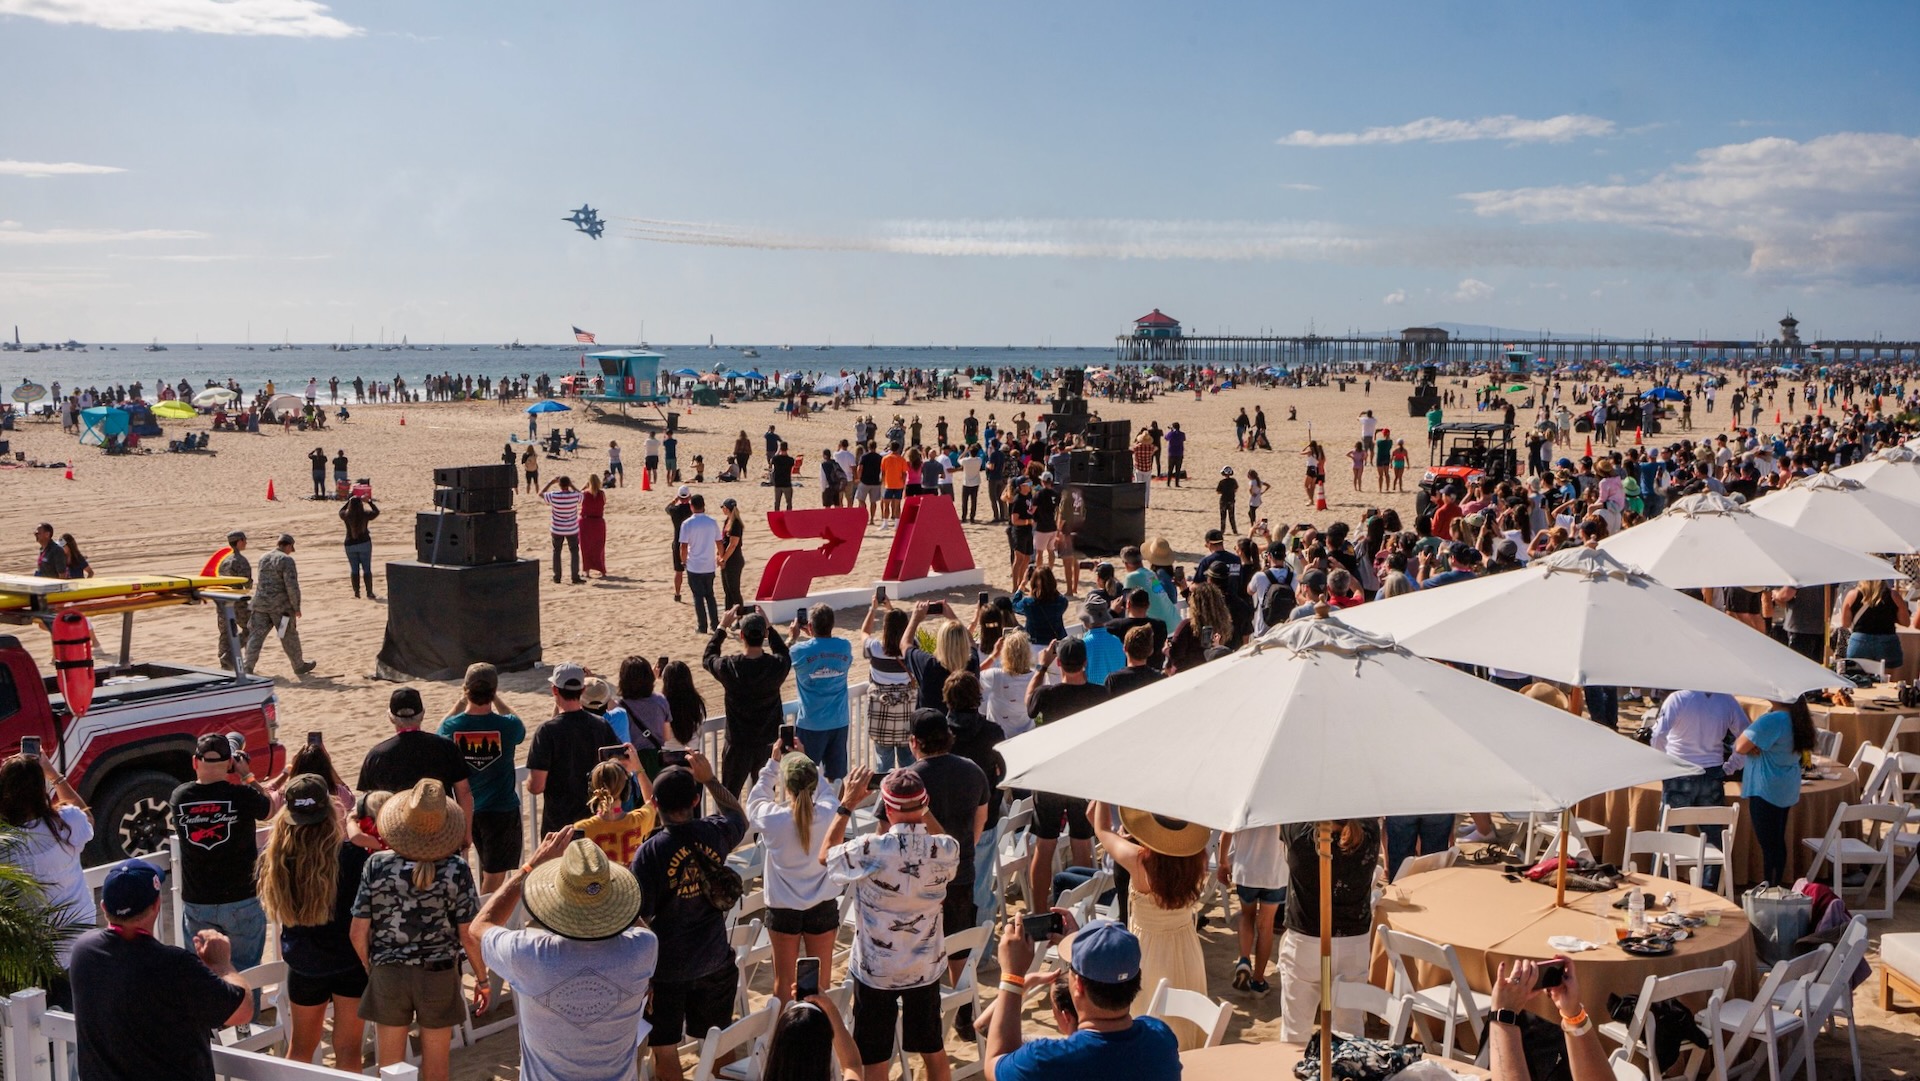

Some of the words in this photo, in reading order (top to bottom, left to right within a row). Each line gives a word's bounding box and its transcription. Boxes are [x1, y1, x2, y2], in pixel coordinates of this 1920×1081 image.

[294, 797, 316, 806] PA
[179, 815, 209, 825] Custom
[210, 813, 238, 823] Shop
